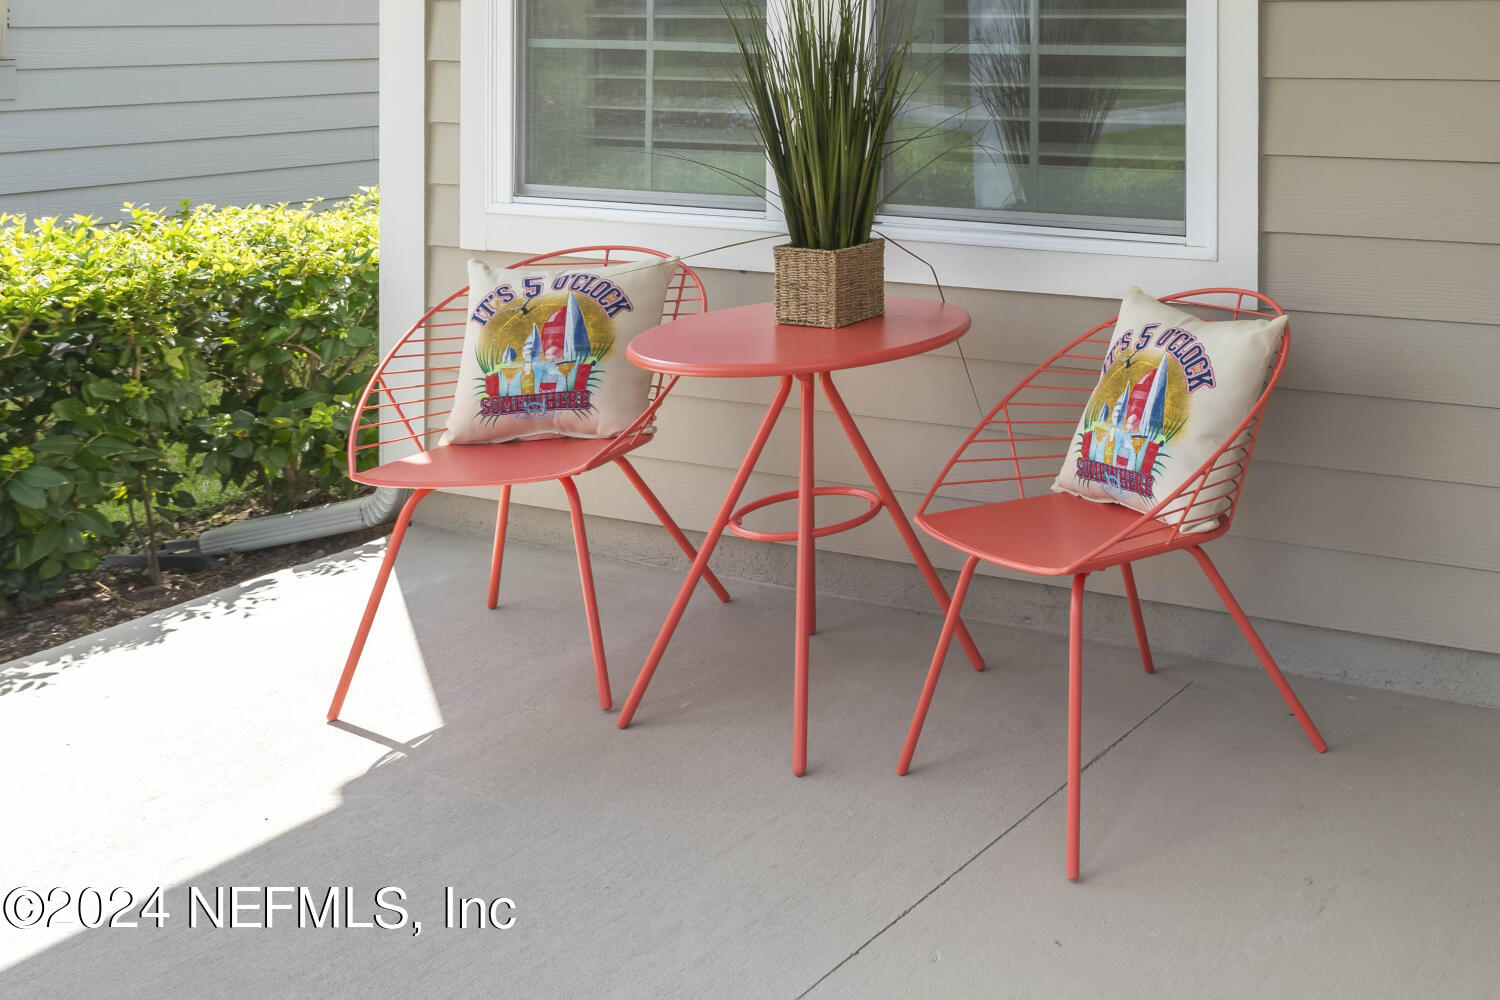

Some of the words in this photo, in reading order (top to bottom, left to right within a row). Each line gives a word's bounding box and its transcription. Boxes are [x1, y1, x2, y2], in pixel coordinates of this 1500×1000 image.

[470, 283, 517, 328] IT'S
[522, 275, 547, 300] 5
[551, 273, 634, 320] O'CLOCK
[1135, 322, 1162, 351] 5
[1155, 327, 1216, 395] O'CLOCK
[480, 390, 592, 417] SOMEWHERE
[1076, 456, 1156, 499] SOMEWHERE
